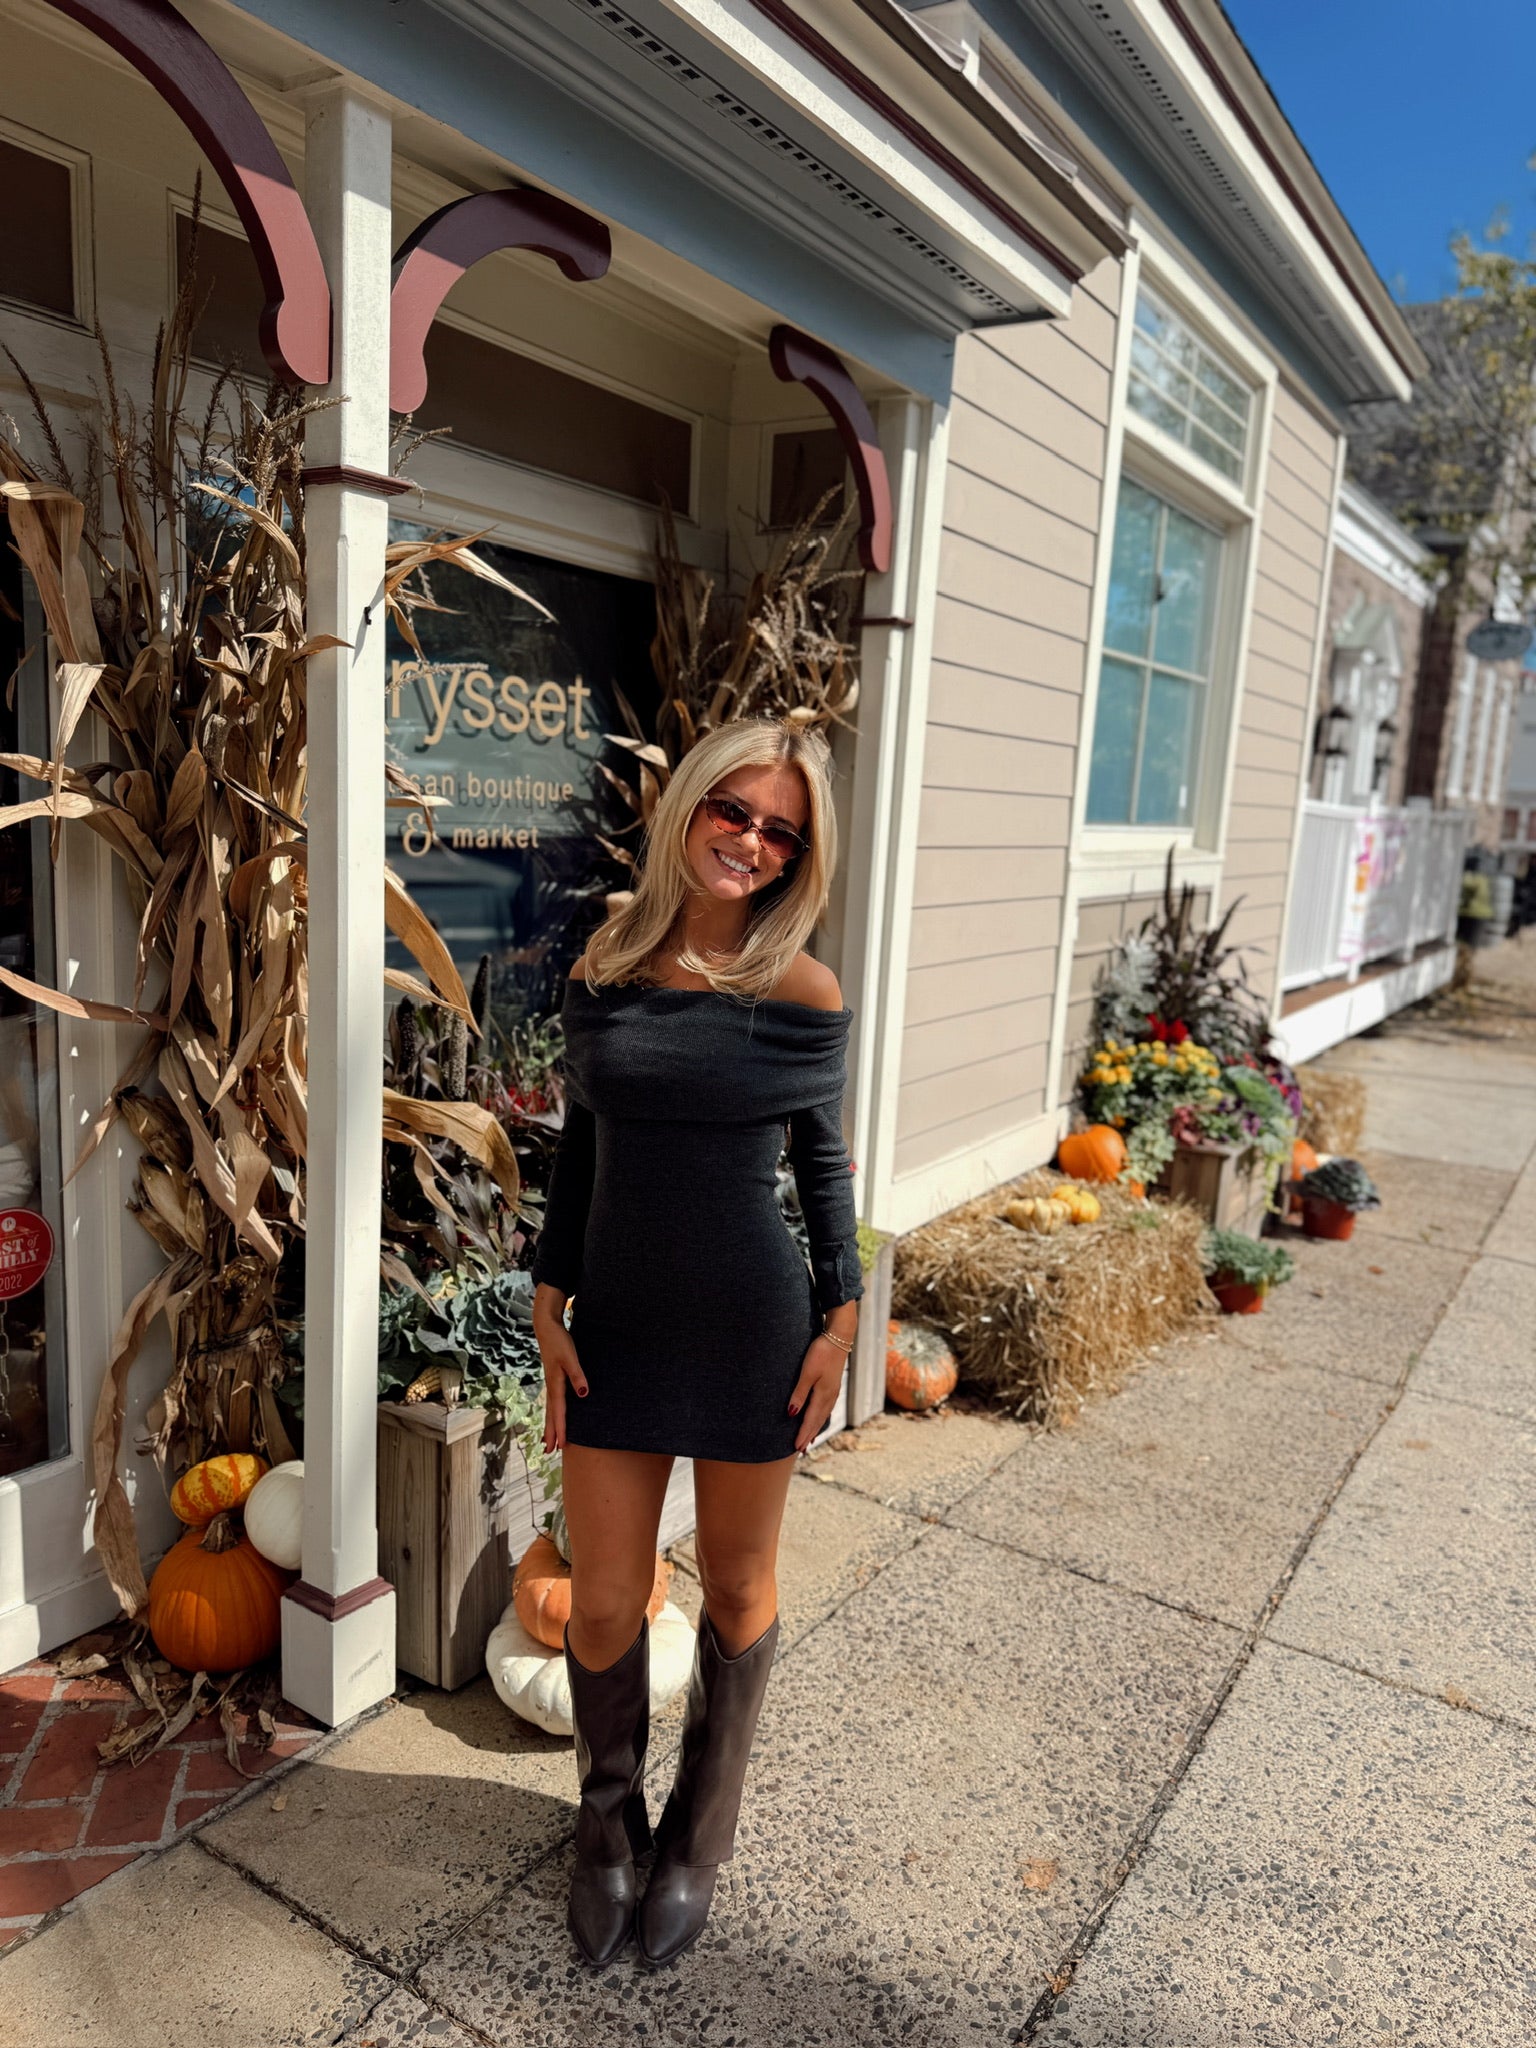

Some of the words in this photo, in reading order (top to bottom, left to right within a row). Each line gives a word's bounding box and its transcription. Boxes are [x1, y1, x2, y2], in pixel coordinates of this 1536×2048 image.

[467, 771, 574, 807] boutique
[402, 812, 432, 858] &
[453, 824, 539, 849] market
[0, 1238, 24, 1256] ST
[27, 1233, 39, 1249] of
